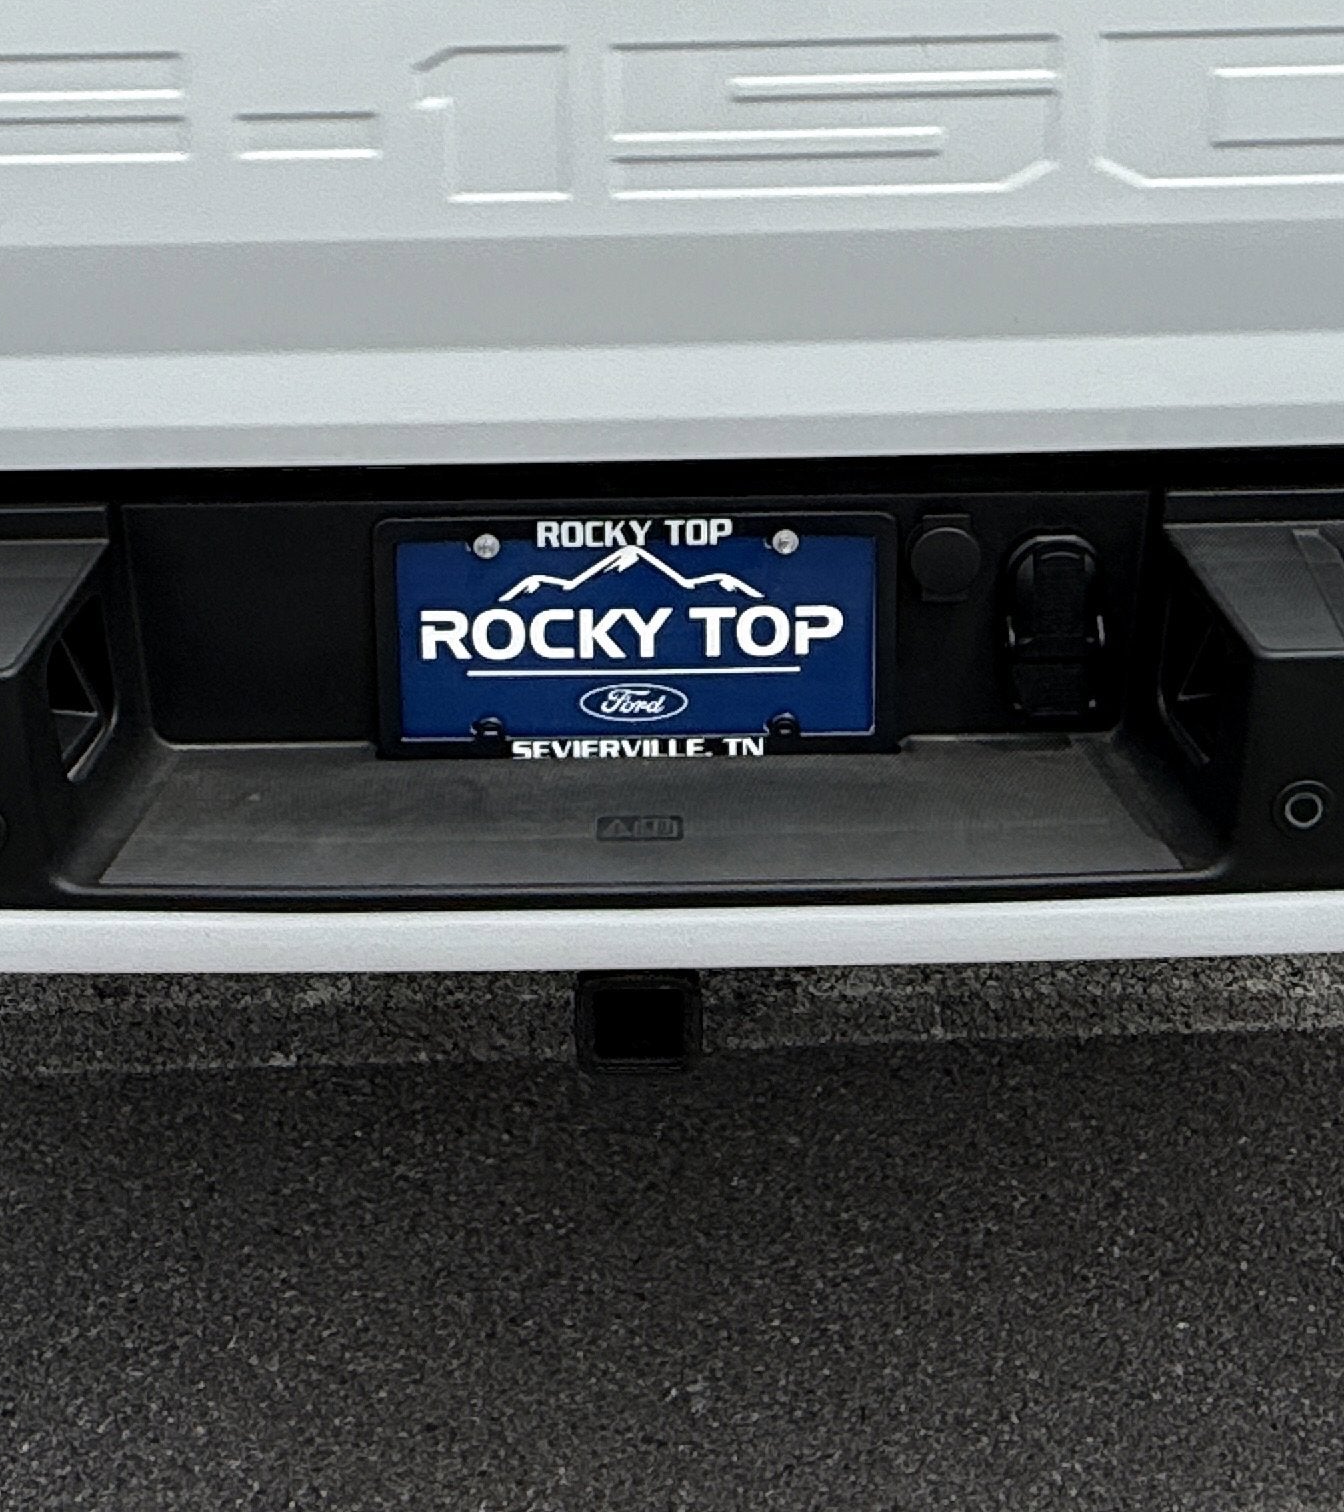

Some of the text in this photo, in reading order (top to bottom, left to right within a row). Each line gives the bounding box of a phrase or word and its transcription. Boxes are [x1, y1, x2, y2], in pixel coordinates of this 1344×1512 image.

[536, 518, 734, 548] ROCKY TOP
[419, 604, 844, 660] ROCKY TOP
[600, 688, 666, 714] Ford
[722, 737, 765, 757] TN
